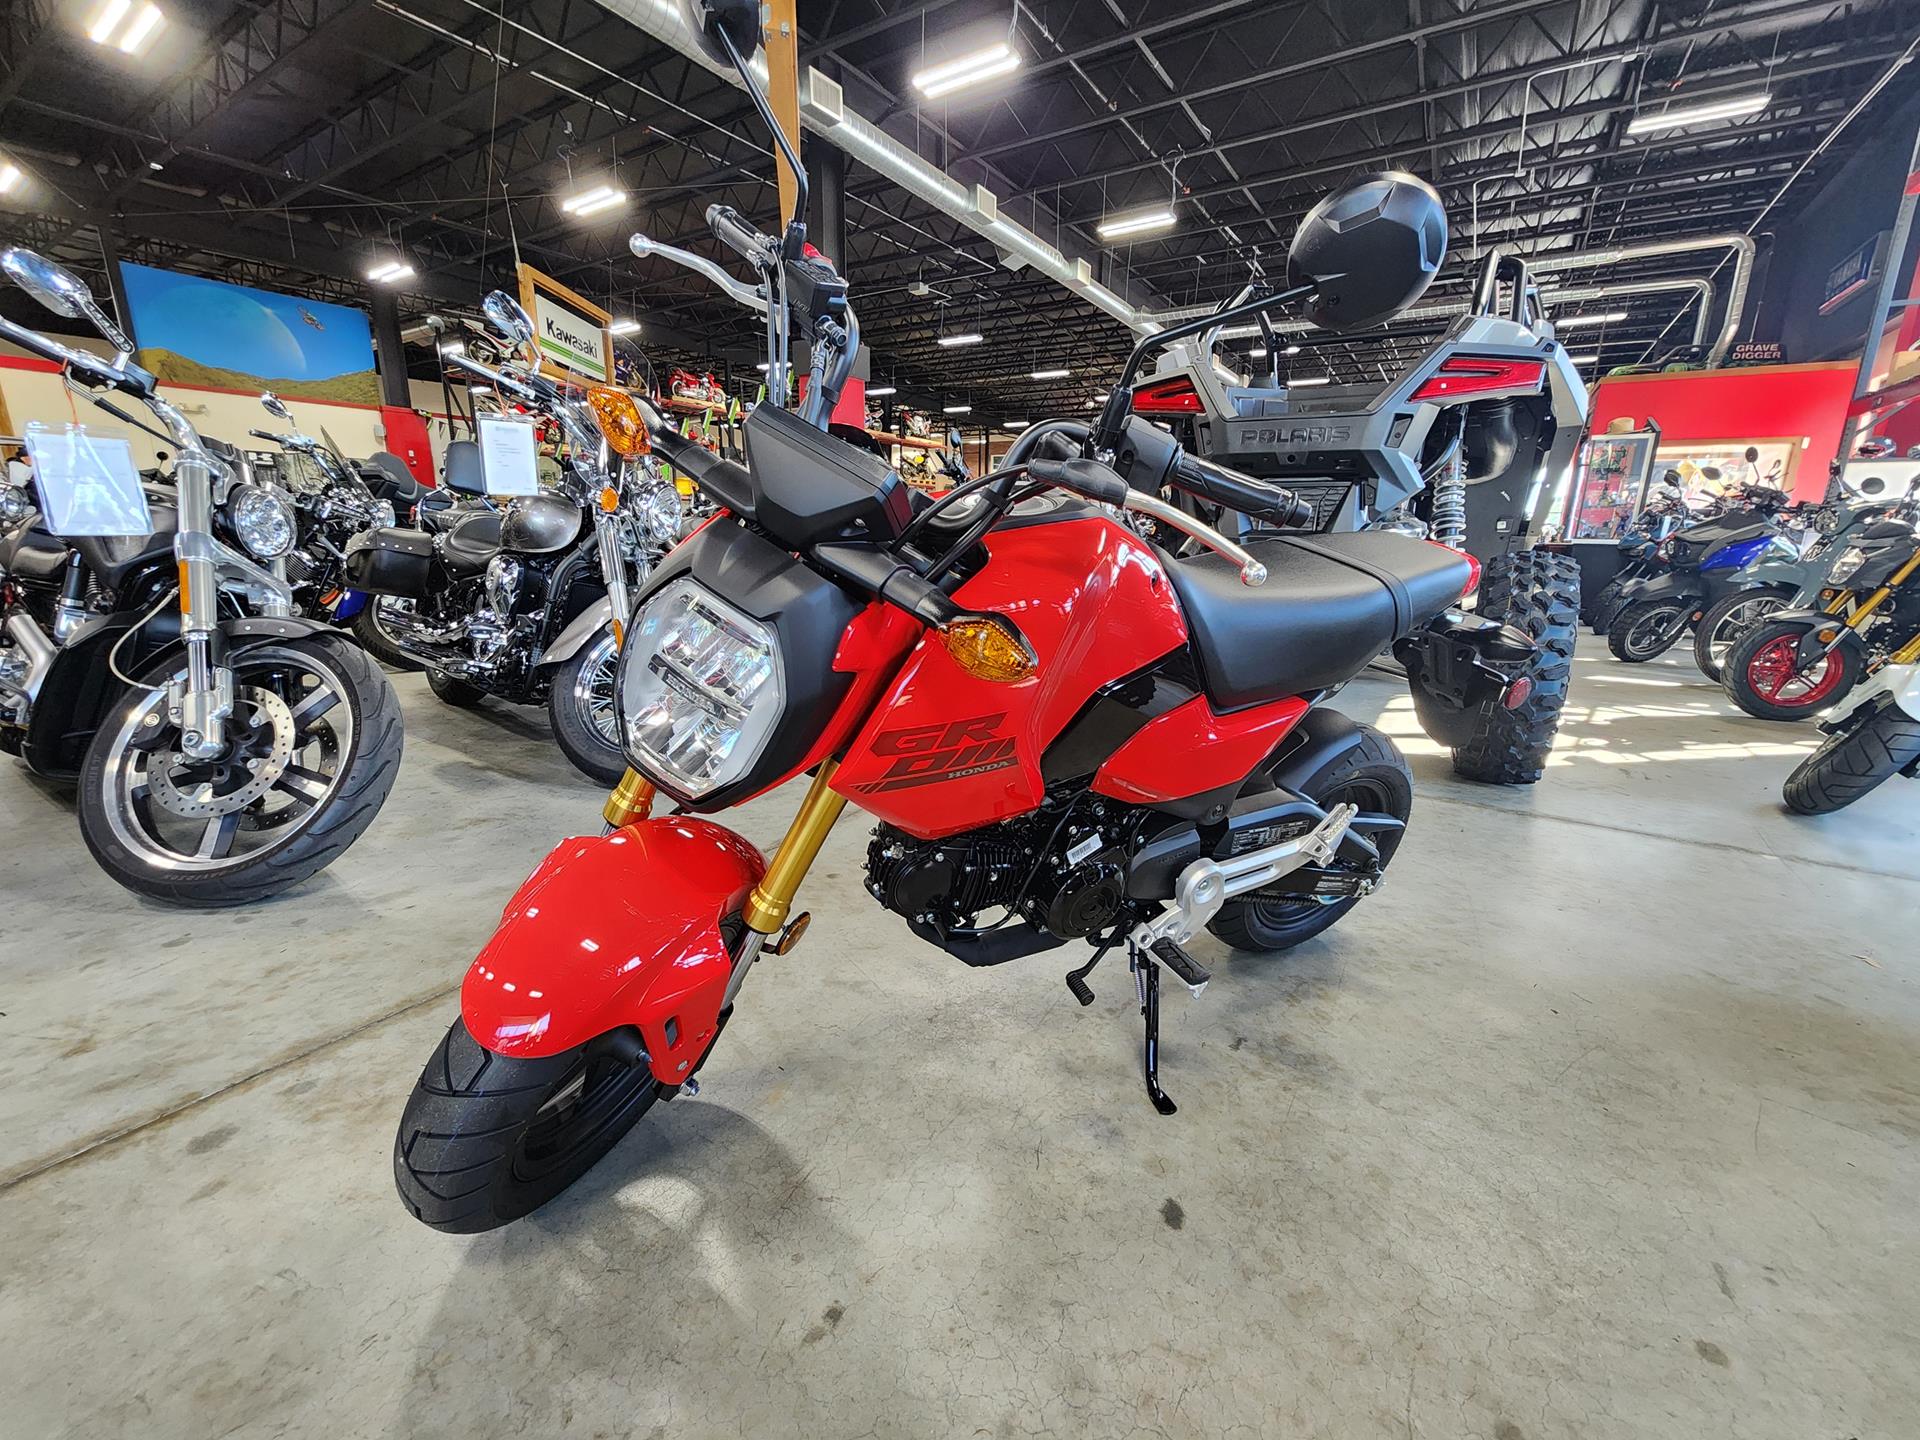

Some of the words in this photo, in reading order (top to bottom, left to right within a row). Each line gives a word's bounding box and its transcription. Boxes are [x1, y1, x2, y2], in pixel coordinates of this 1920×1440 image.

[546, 317, 598, 359] Kawasaki
[1735, 343, 1779, 352] GRAVE
[1732, 351, 1781, 360] DIGGER
[1241, 426, 1351, 445] POLARIS
[947, 760, 1010, 780] HONDA
